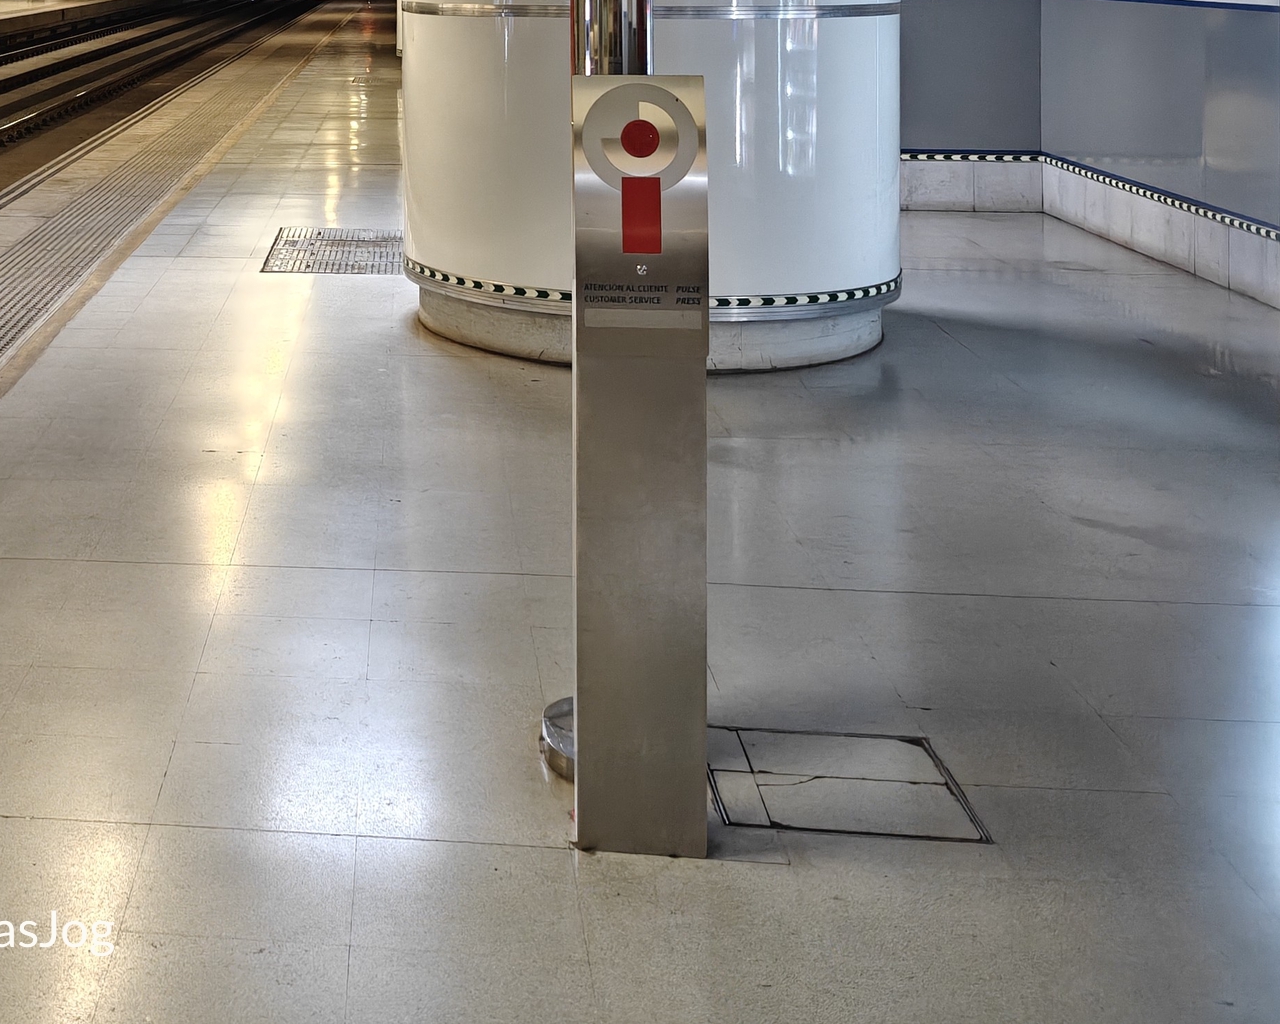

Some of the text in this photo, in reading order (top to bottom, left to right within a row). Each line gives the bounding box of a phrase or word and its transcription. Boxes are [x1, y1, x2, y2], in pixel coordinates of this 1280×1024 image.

[637, 284, 668, 293] CLIENTE
[675, 285, 701, 294] PULSE
[584, 295, 661, 304] CUSTOMER SERVICE
[675, 297, 702, 305] PRESS
